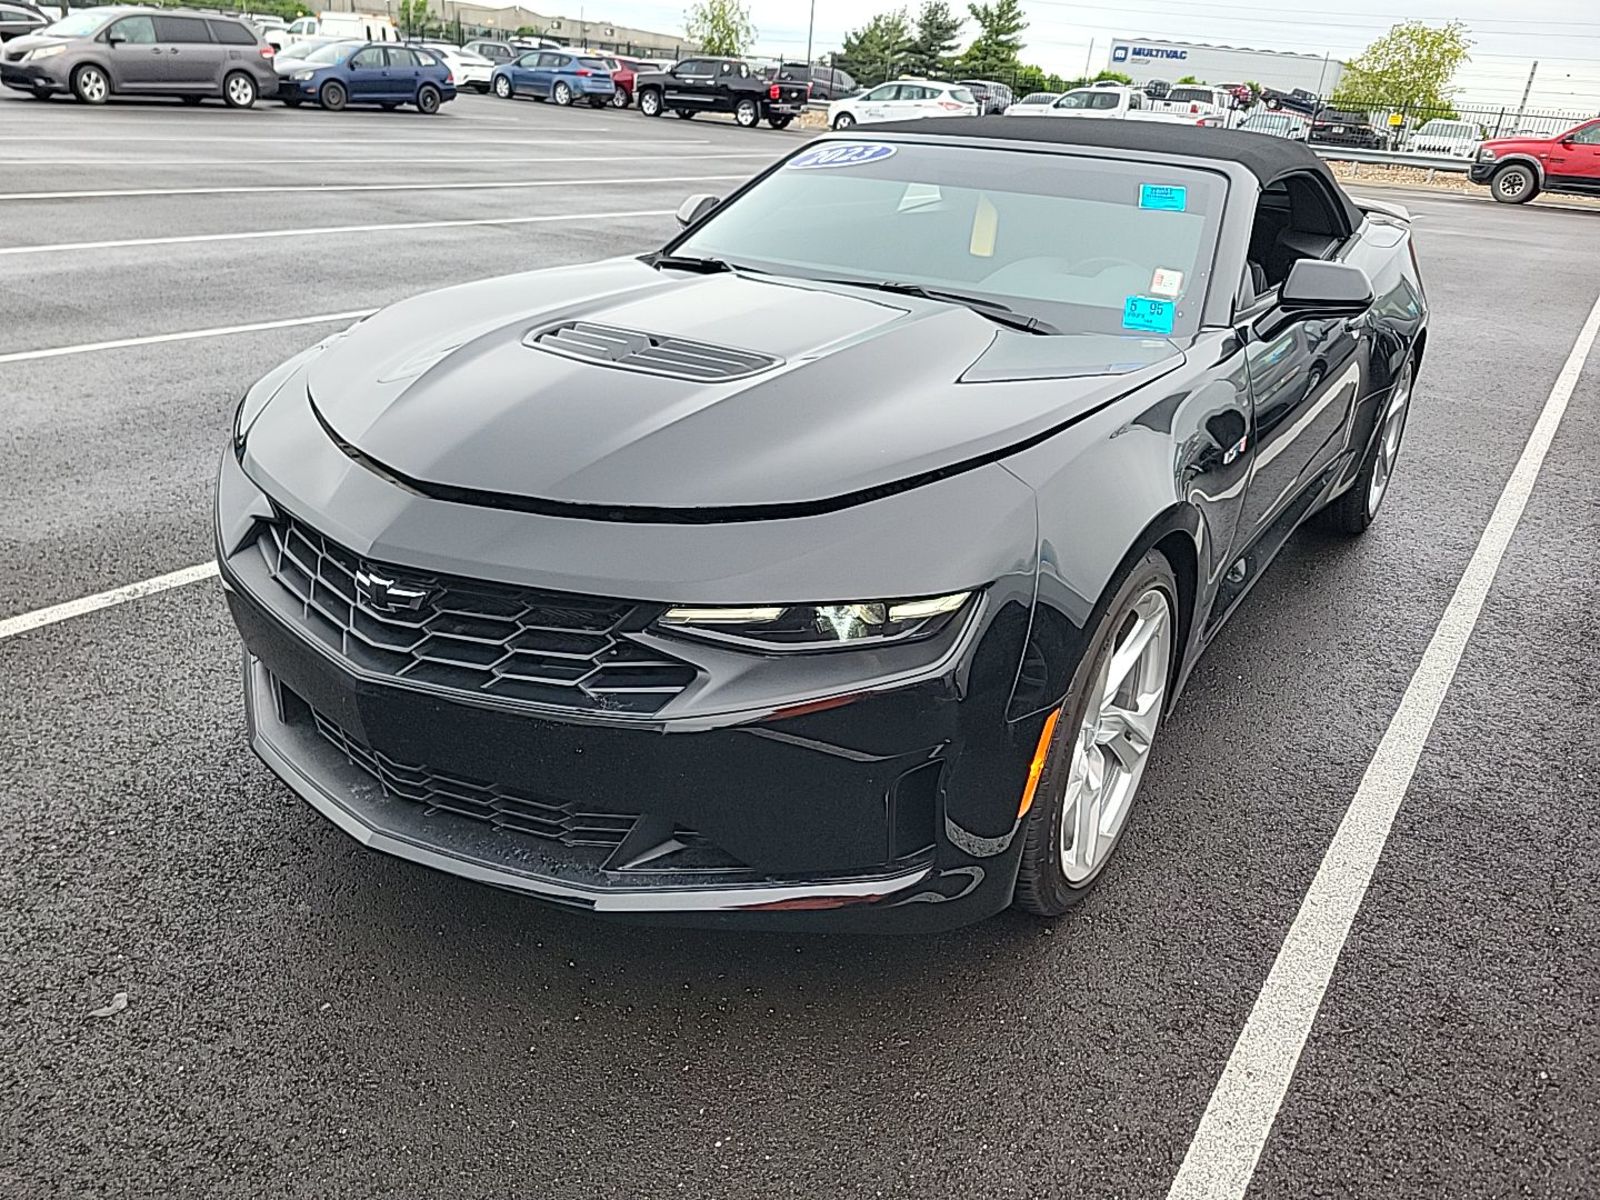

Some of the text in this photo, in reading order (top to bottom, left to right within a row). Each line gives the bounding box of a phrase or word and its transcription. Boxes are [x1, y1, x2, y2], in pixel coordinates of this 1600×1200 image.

[1132, 47, 1187, 60] MULTIVAC
[799, 145, 880, 166] 2023
[1150, 302, 1164, 316] 95
